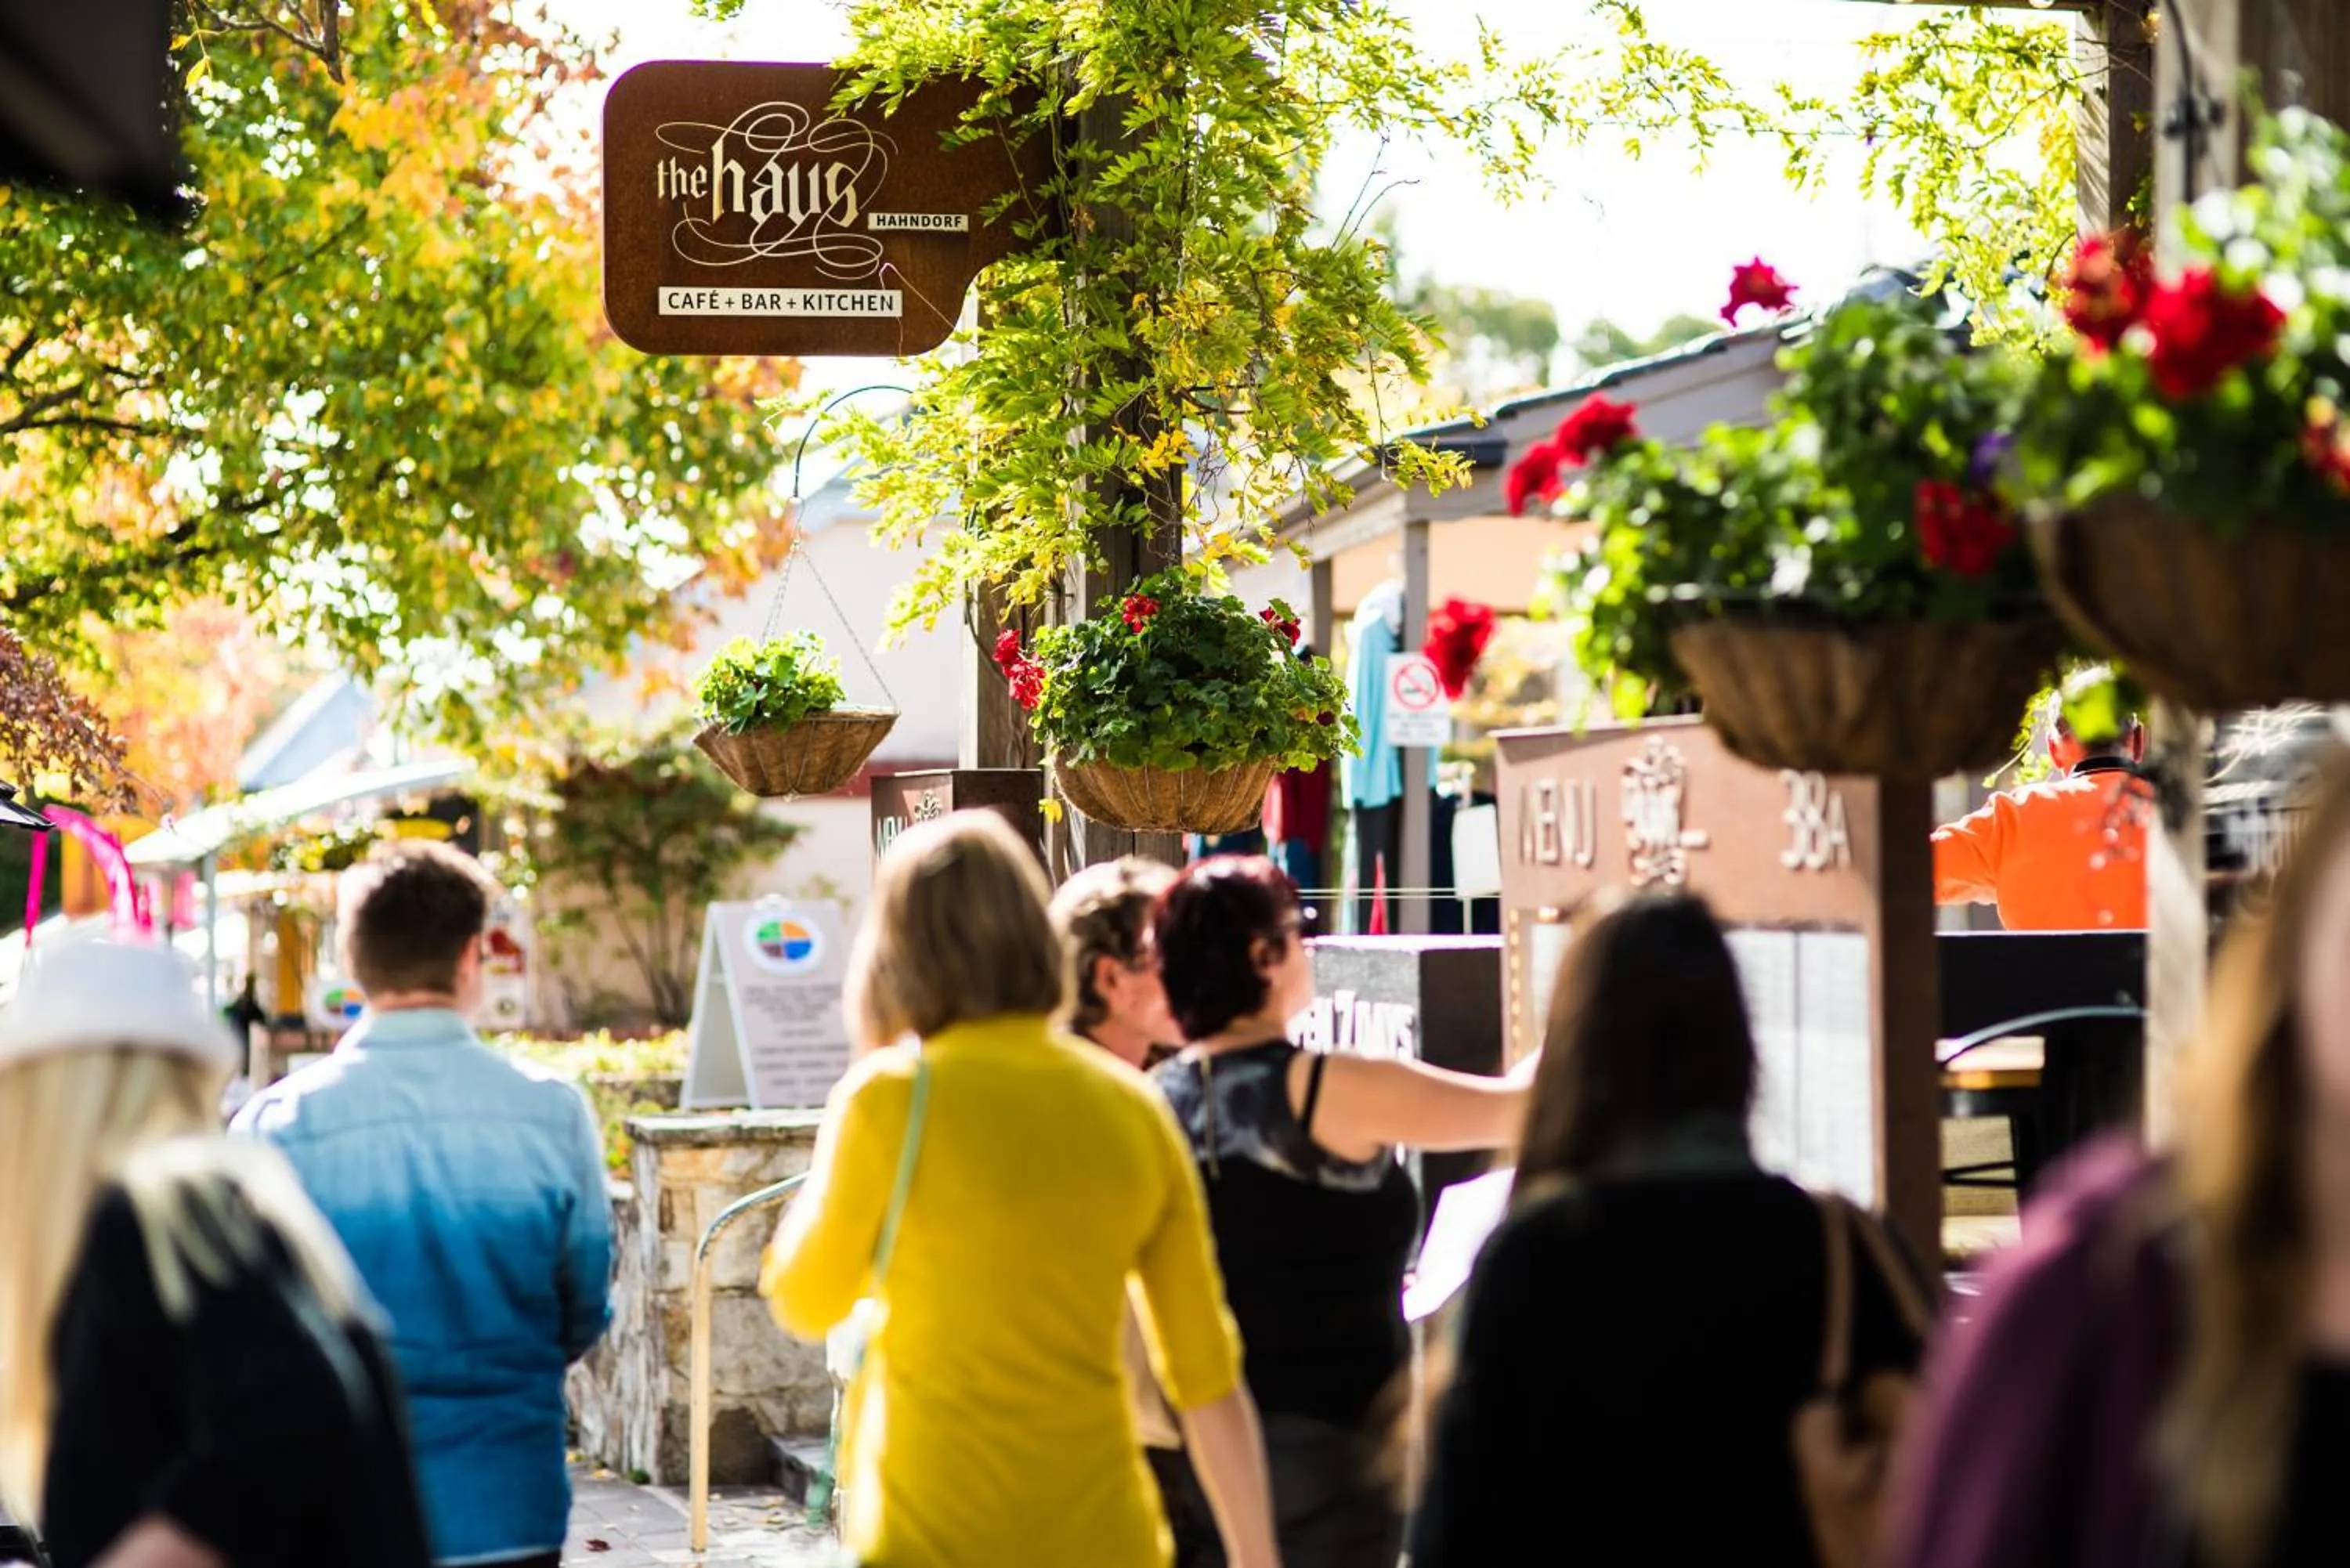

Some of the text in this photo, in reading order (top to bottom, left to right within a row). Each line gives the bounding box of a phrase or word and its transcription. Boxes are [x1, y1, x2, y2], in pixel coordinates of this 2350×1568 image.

[656, 135, 859, 228] the haus
[876, 214, 963, 228] HAHNDORF
[667, 290, 720, 310] CAFÉ
[742, 293, 782, 311] BAR
[803, 294, 895, 312] KITCHEN
